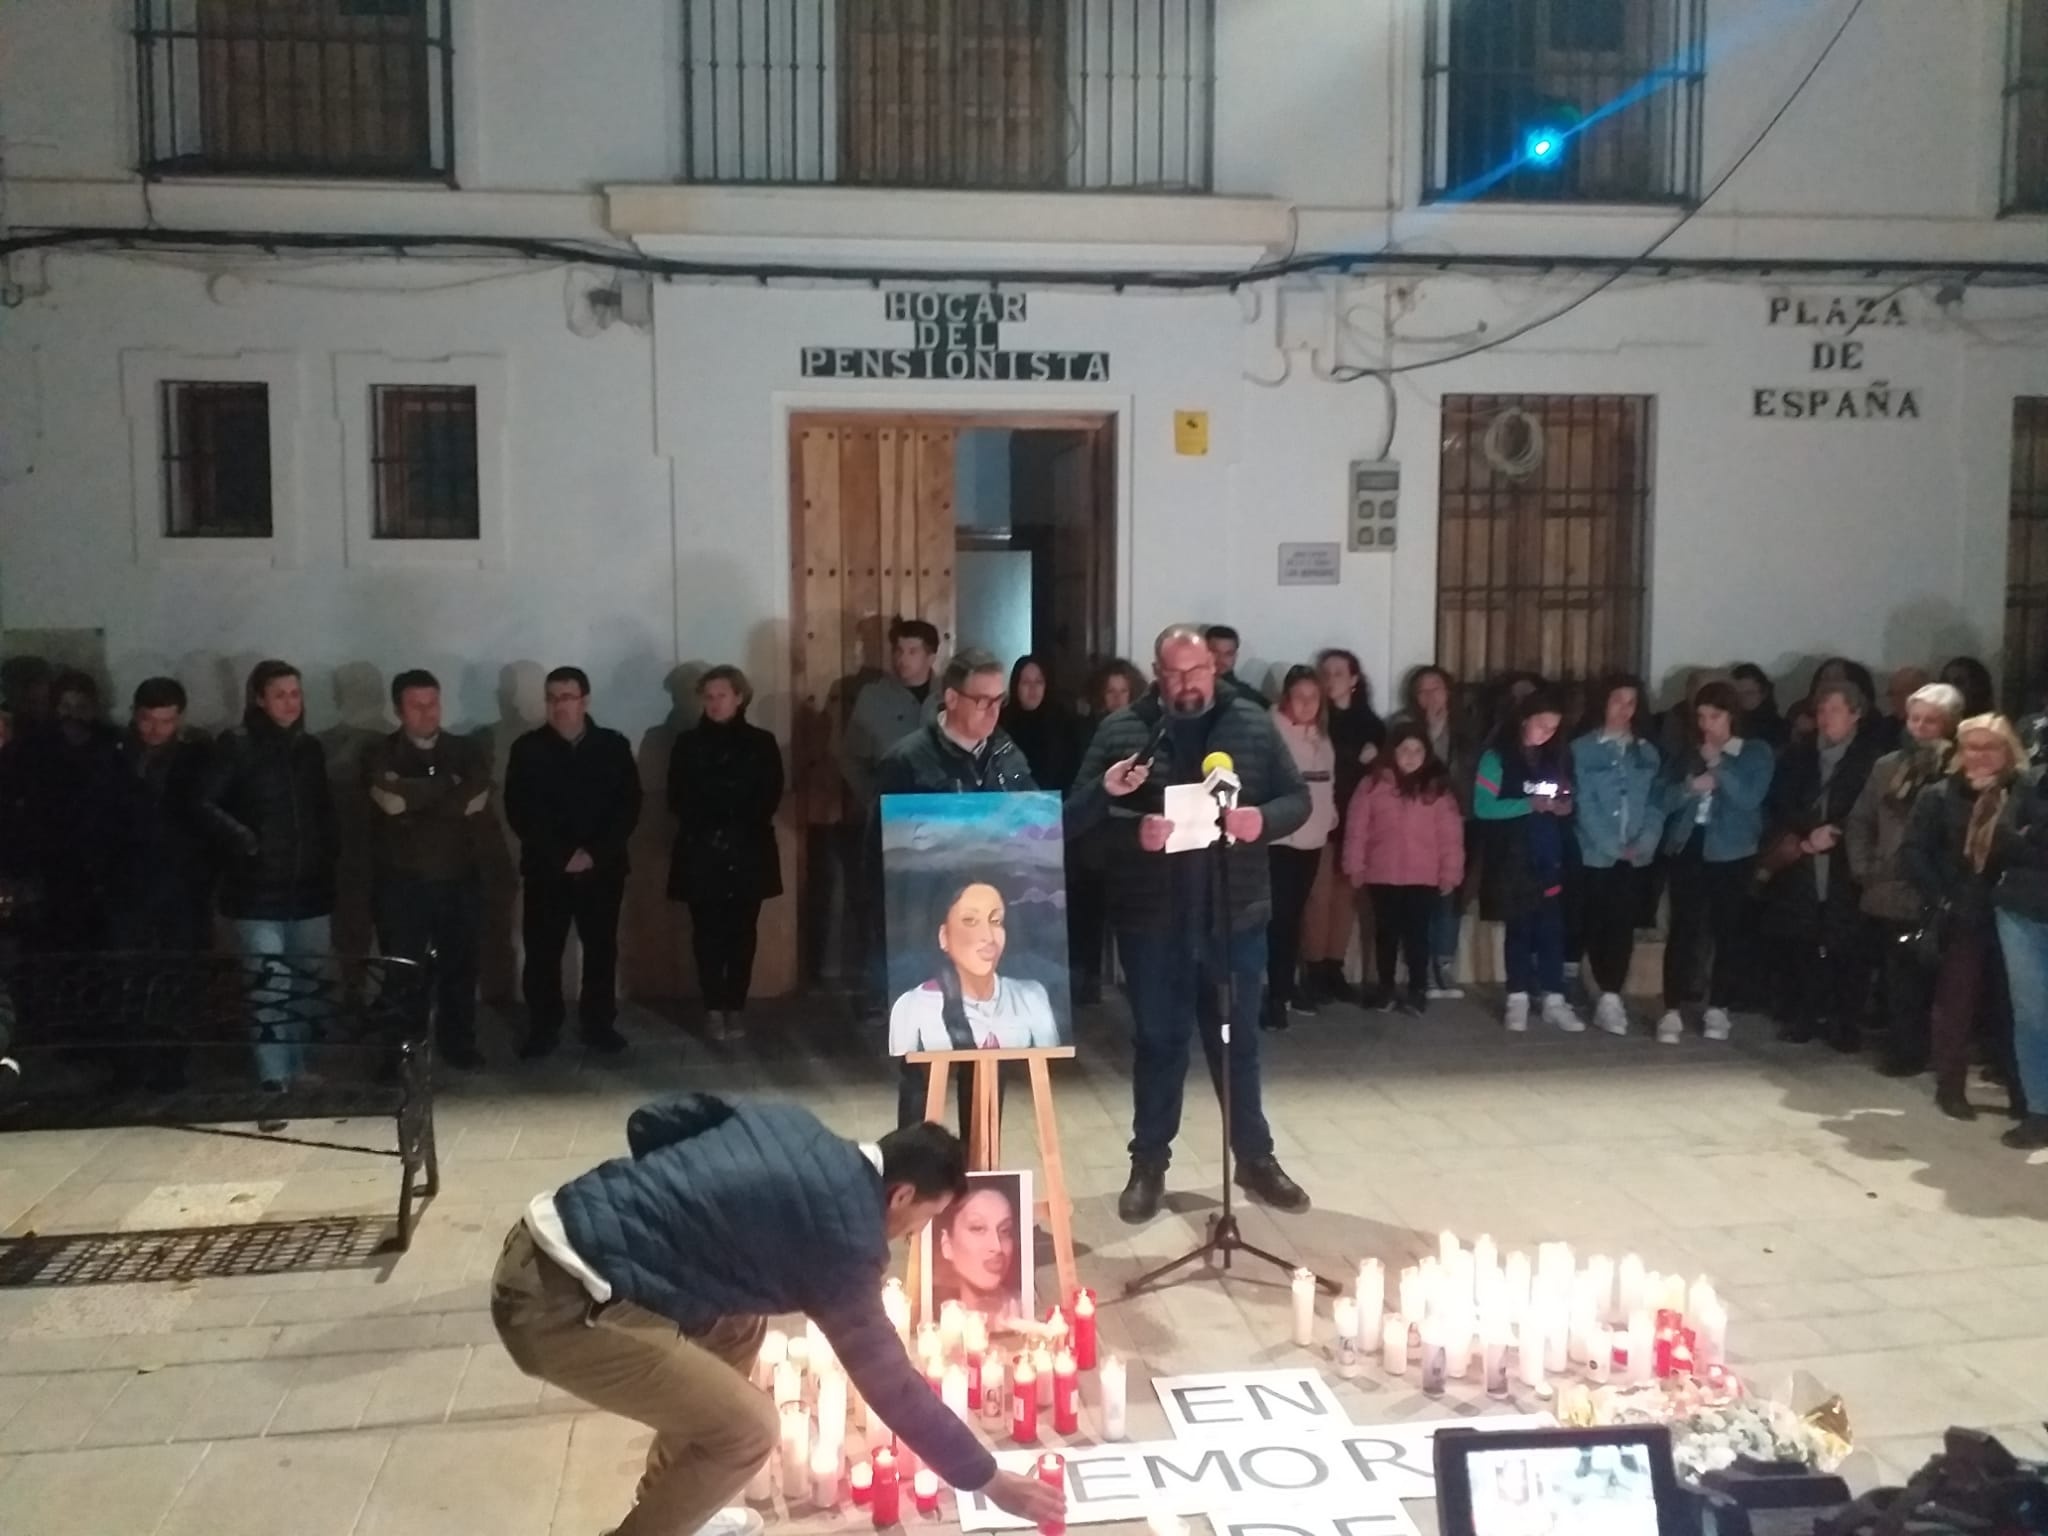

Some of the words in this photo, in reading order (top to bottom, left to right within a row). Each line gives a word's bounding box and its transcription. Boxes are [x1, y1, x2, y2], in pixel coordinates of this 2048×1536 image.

[888, 293, 1024, 321] HOGAR
[1769, 297, 1907, 326] PLAZA
[918, 322, 996, 350] DEL
[804, 350, 1108, 380] PENSIONISTA
[1812, 341, 1865, 370] DE
[1752, 378, 1920, 418] ESPAÑA
[1171, 1380, 1328, 1425] EN
[973, 1438, 1435, 1511] EMOR
